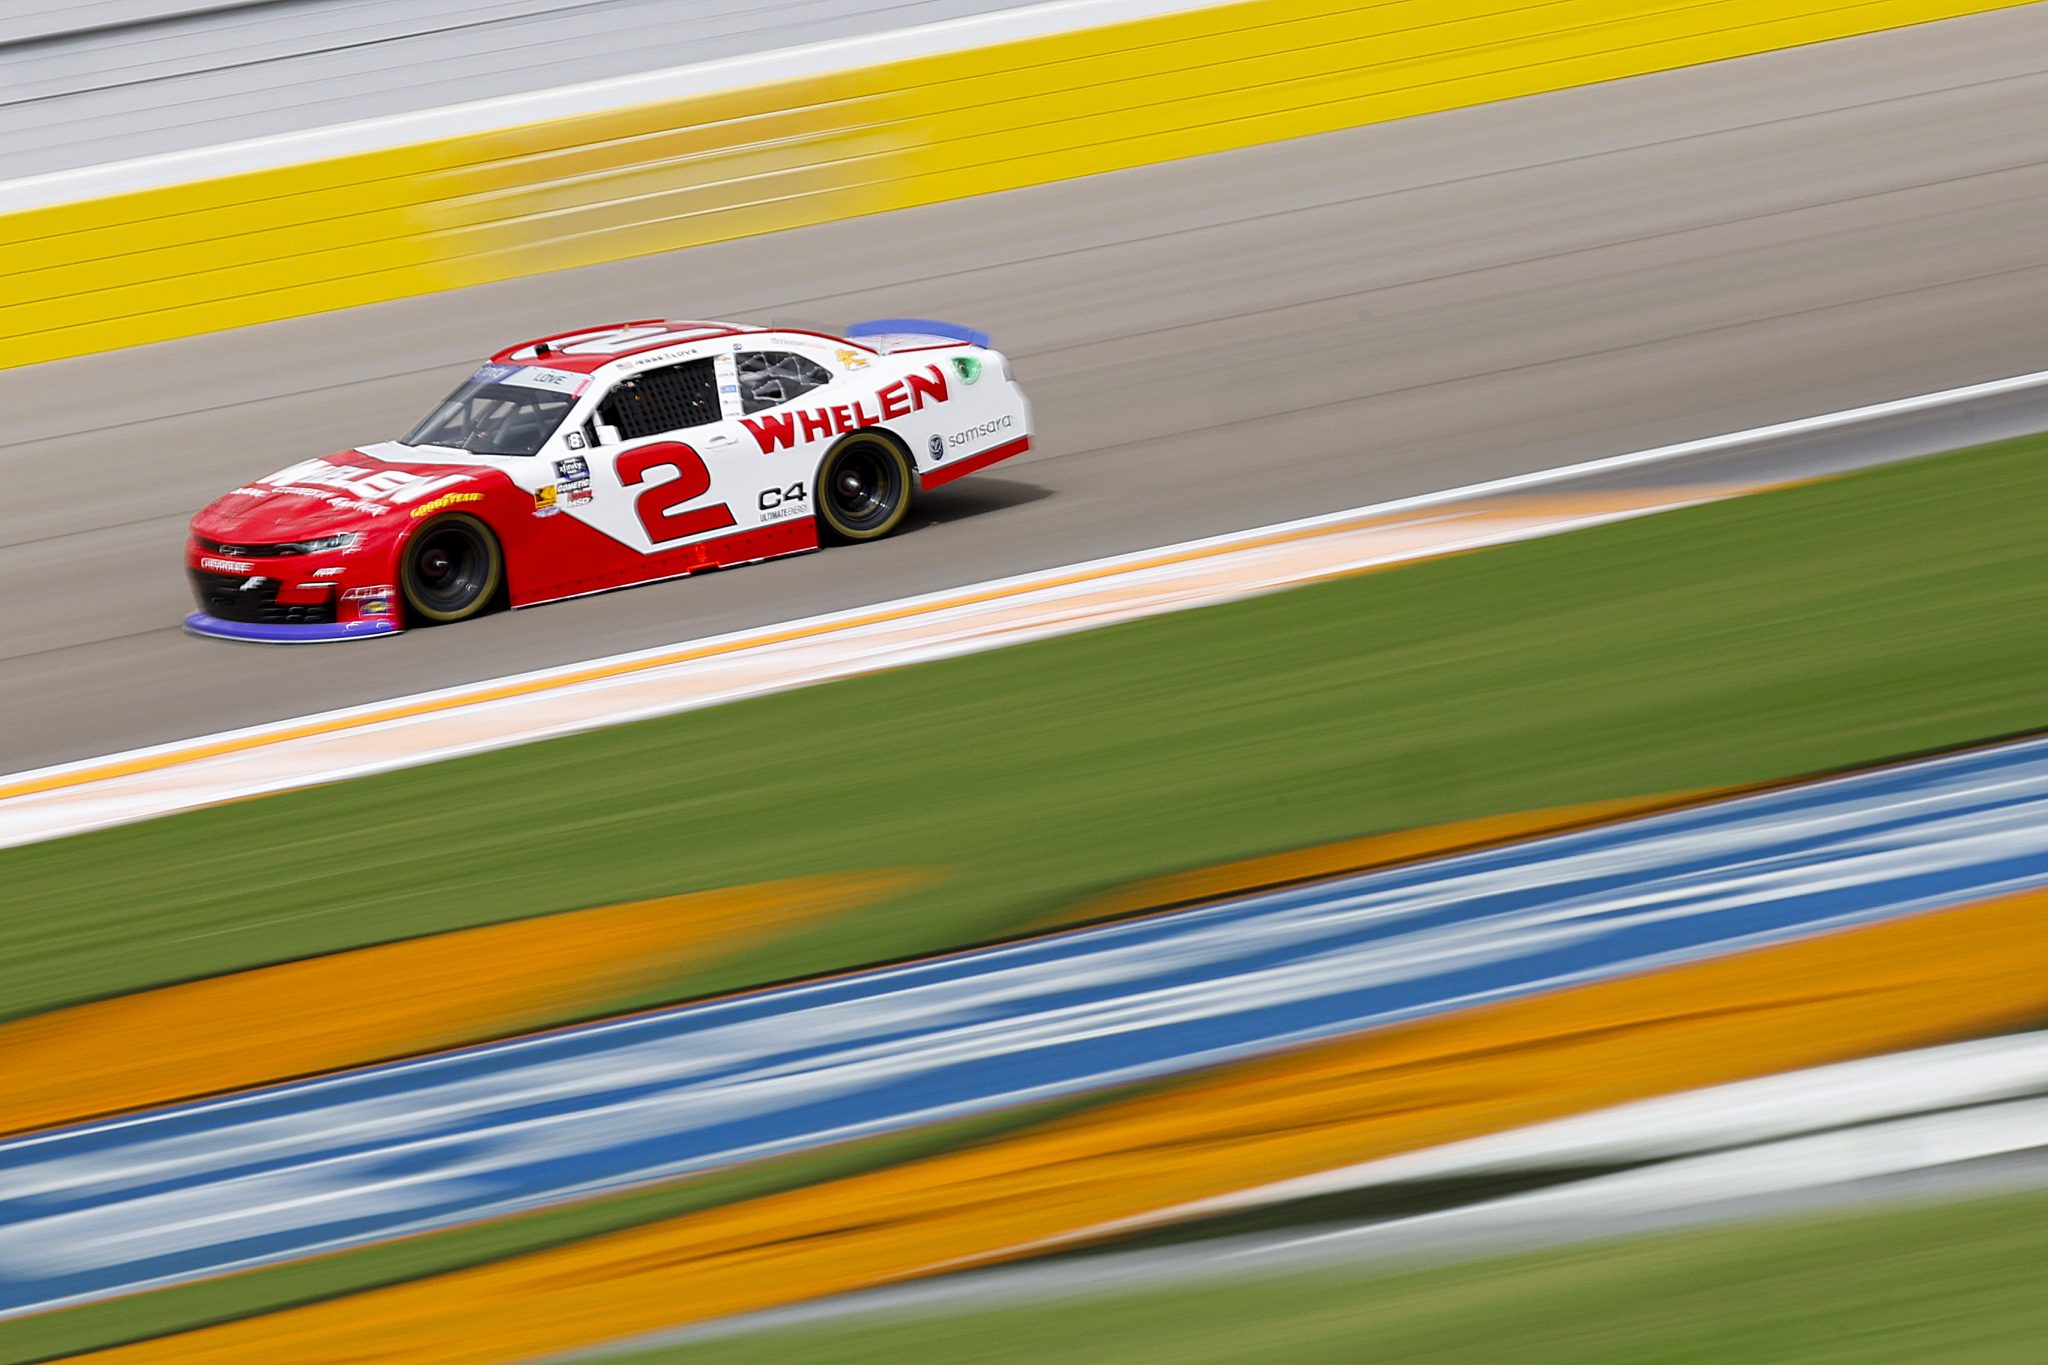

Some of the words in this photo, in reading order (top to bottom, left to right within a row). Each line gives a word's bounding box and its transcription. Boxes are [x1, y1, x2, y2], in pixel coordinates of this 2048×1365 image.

[534, 373, 567, 385] LOVE
[740, 364, 948, 454] WHELEN
[948, 415, 1012, 448] samsara
[409, 492, 486, 518] GOODYEAR
[613, 441, 737, 544] 2
[758, 481, 807, 511] C4
